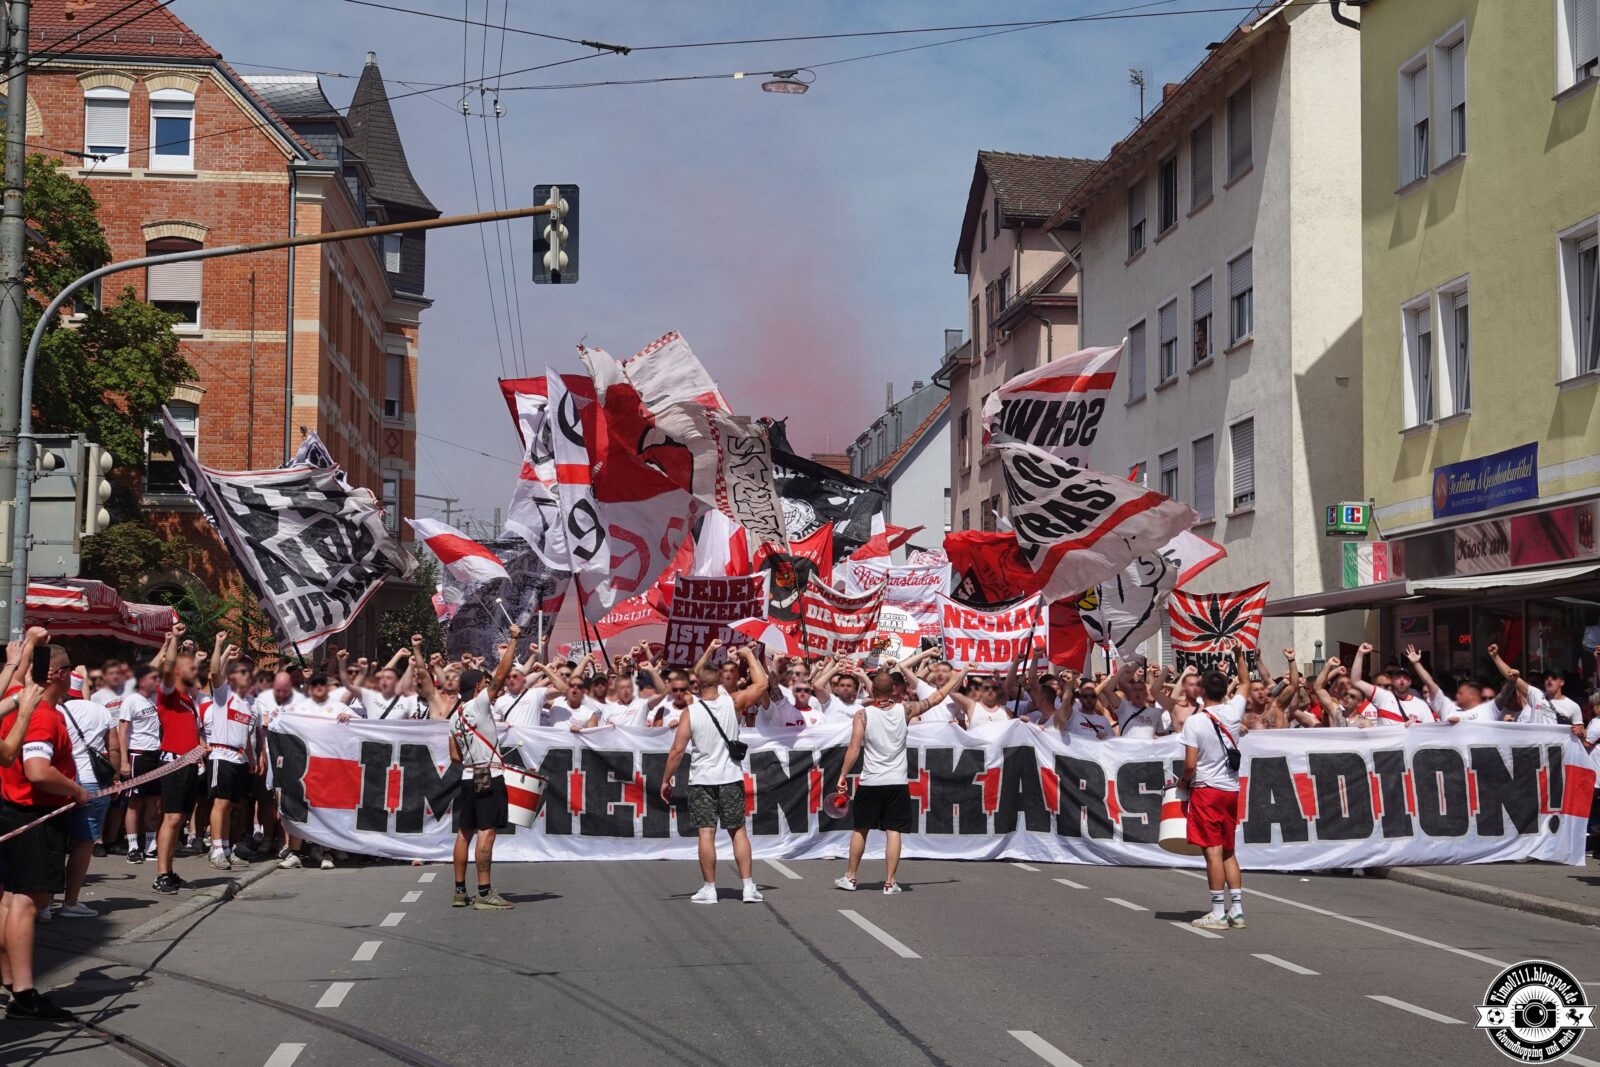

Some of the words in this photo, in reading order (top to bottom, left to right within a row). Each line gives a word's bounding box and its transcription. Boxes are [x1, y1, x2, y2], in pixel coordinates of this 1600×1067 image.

[1457, 531, 1488, 560] Kiosk
[675, 576, 764, 602] JEDER
[673, 599, 763, 620] EINZELNE
[806, 604, 833, 623] DIE
[943, 603, 1045, 633] NECKAR
[670, 622, 710, 644] IST
[718, 626, 755, 645] DE
[667, 644, 693, 665] 12.
[945, 634, 1049, 663] STADION
[752, 744, 1565, 844] NEKARSADION!
